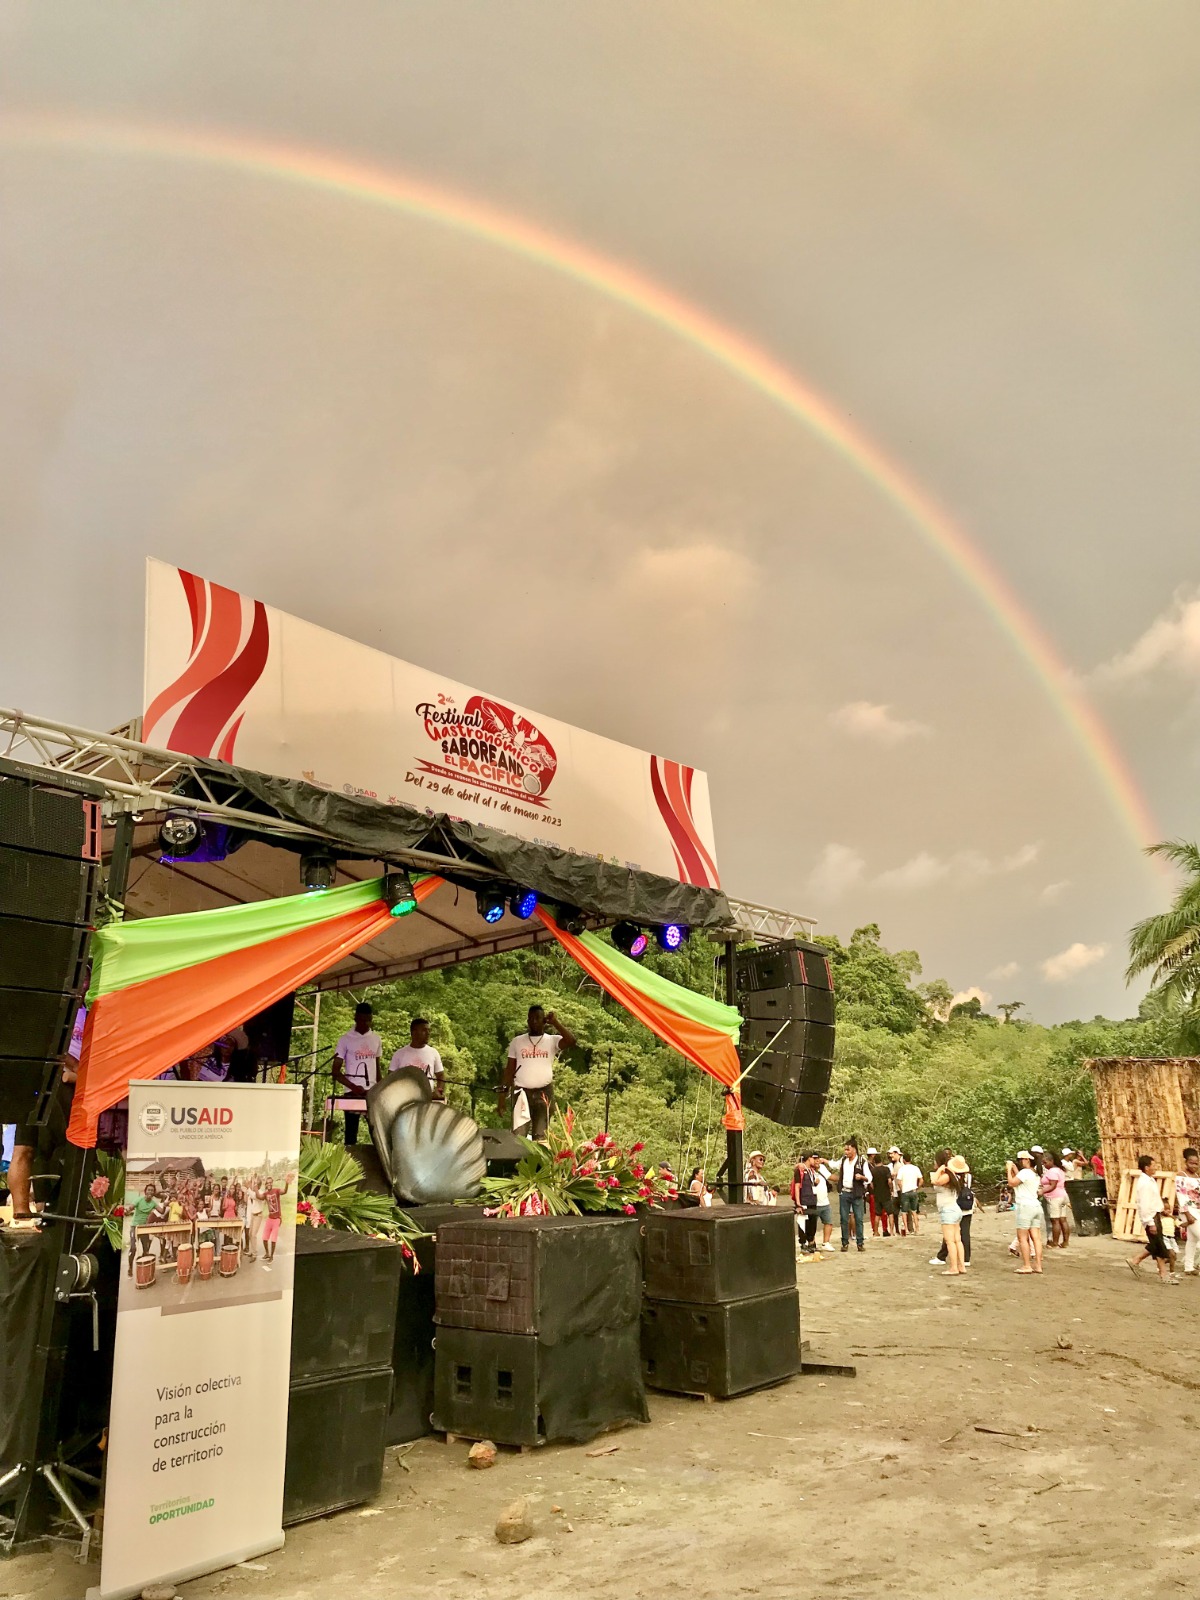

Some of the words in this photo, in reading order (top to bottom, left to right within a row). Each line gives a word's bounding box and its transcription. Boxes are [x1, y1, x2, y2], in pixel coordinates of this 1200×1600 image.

[415, 702, 482, 728] Festival
[424, 718, 539, 773] Gastronómico
[444, 754, 458, 767] EL
[353, 786, 378, 798] USAID
[404, 771, 425, 788] Del
[426, 781, 439, 792] 29
[441, 783, 455, 796] de
[456, 788, 481, 805] abril
[482, 796, 492, 807] al
[493, 800, 498, 809] 1
[500, 800, 512, 812] de
[513, 806, 539, 821] mayo
[541, 814, 562, 827] 2023
[171, 1107, 234, 1125] USAID
[156, 1383, 192, 1401] Visión
[195, 1374, 242, 1395] colectiva
[154, 1411, 180, 1430] para
[184, 1405, 193, 1420] la
[153, 1420, 226, 1449] construcción
[152, 1458, 167, 1473] de
[170, 1444, 224, 1468] territorio
[149, 1498, 215, 1525] OPORTUNIDAD
[150, 1495, 191, 1513] Territorios
